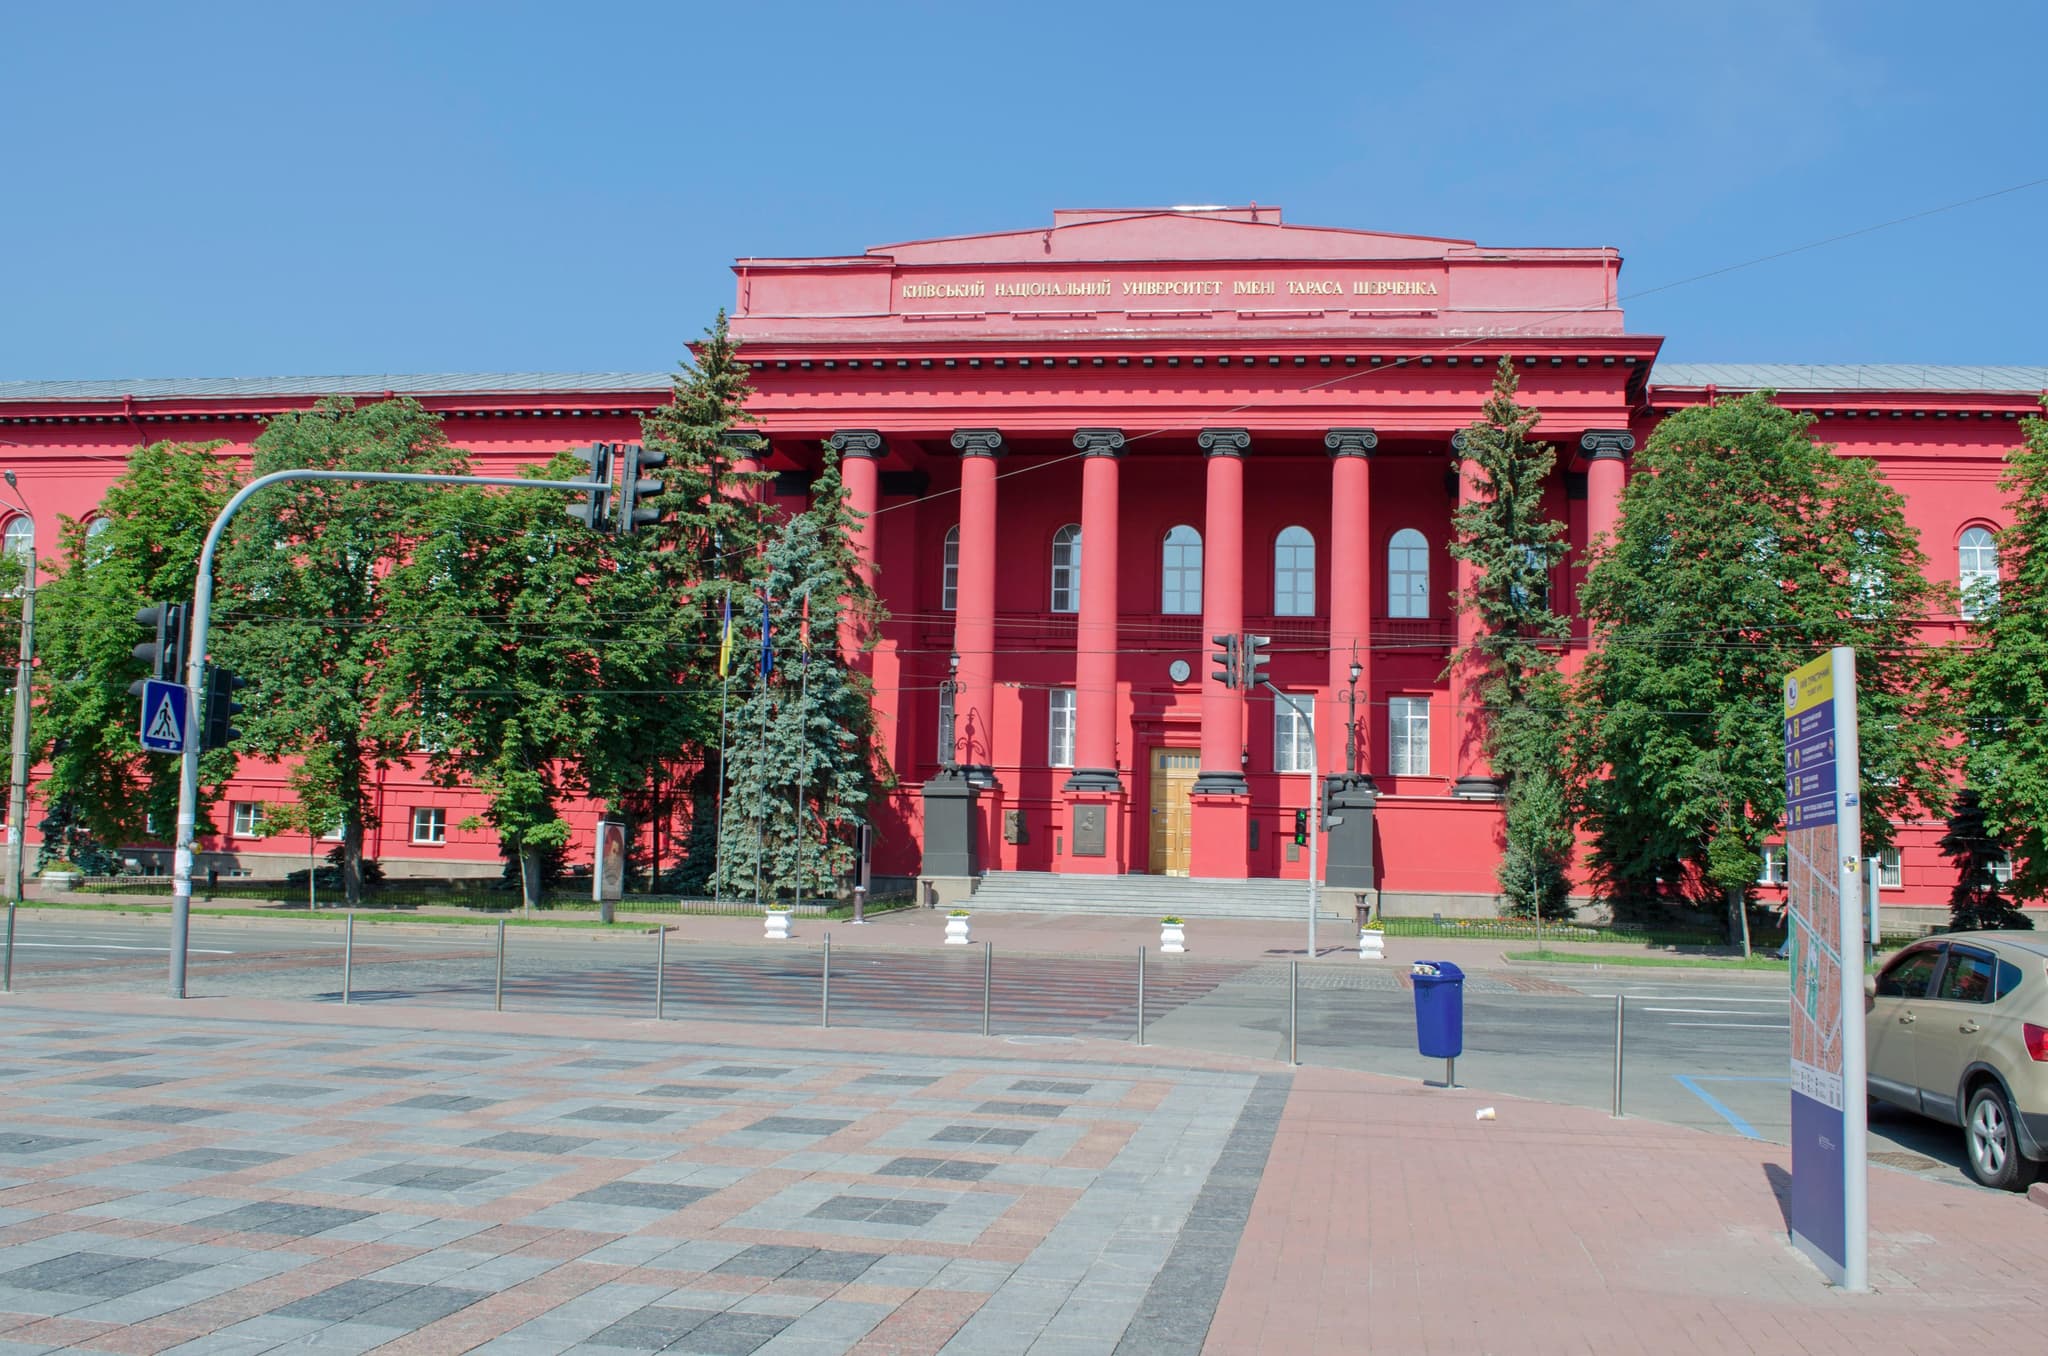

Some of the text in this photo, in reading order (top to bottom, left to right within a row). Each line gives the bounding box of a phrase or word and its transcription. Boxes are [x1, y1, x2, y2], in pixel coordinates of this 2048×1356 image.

[902, 280, 1438, 298] КИЇВСЬКИЙ НАЦІОНАЛЬНИЙ УНІВЕРСИТЕТ ІМЕНІ ТАРАСА ШЕВЧЕНКА
